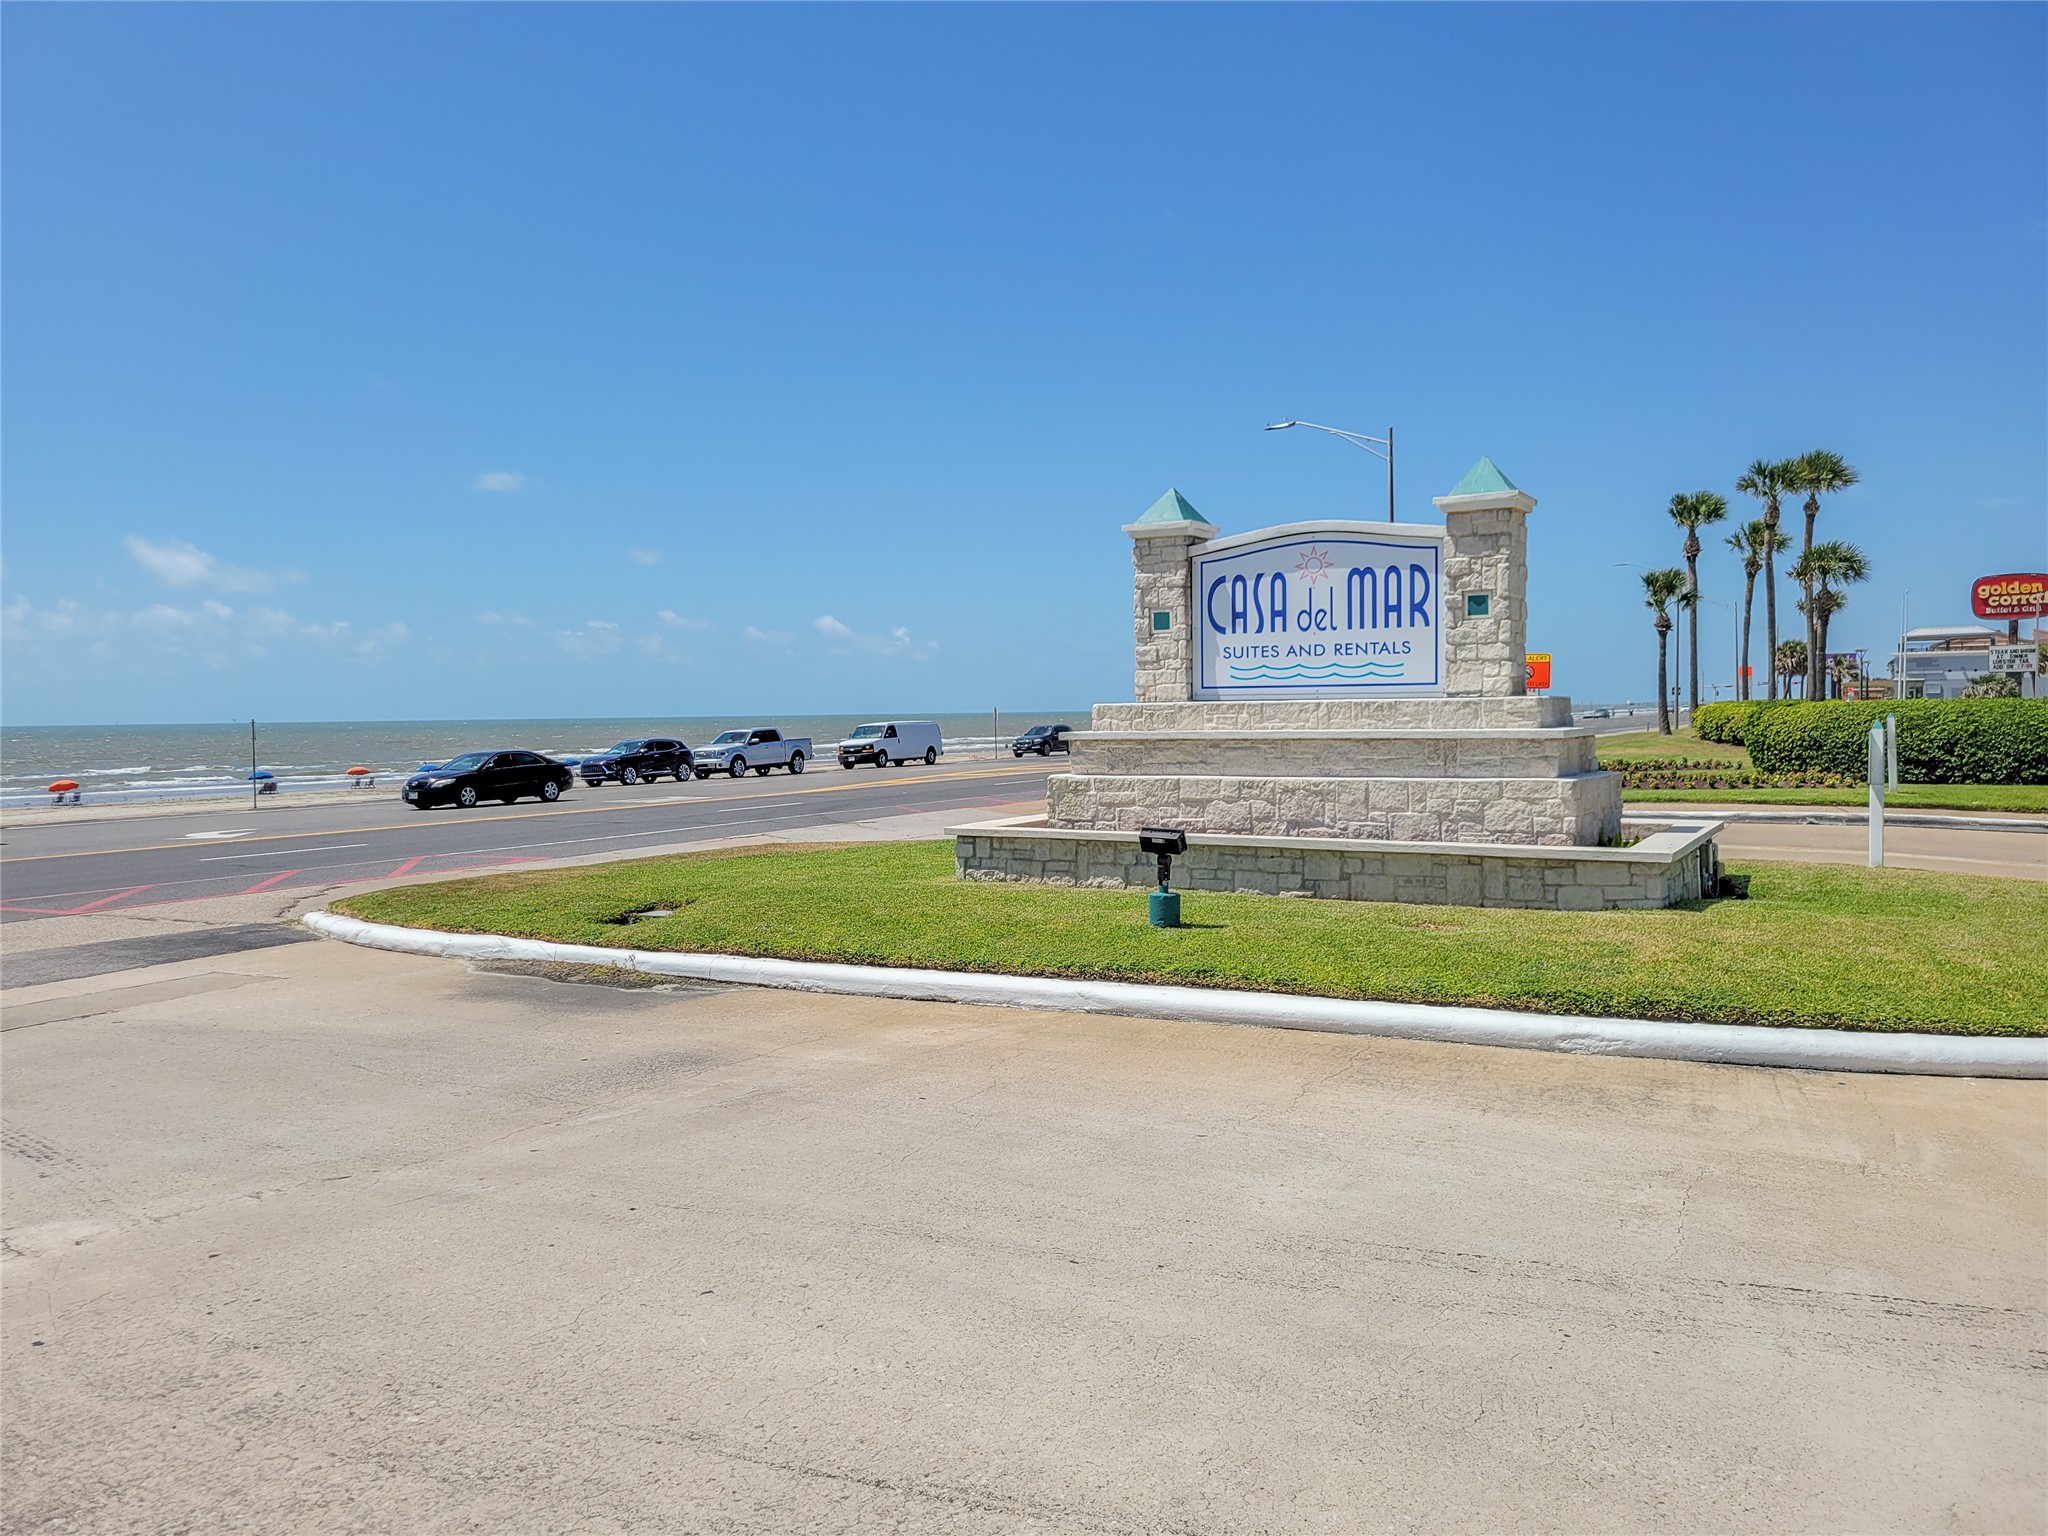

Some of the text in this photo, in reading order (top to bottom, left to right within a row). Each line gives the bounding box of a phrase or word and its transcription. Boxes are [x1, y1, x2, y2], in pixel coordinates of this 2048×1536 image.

[1977, 581, 2043, 598] golden
[1207, 563, 1431, 635] CASA del MAR
[1988, 591, 2048, 606] corral
[1985, 606, 2012, 614] Buffet
[1223, 641, 1411, 660] SUITES AND RENTALS
